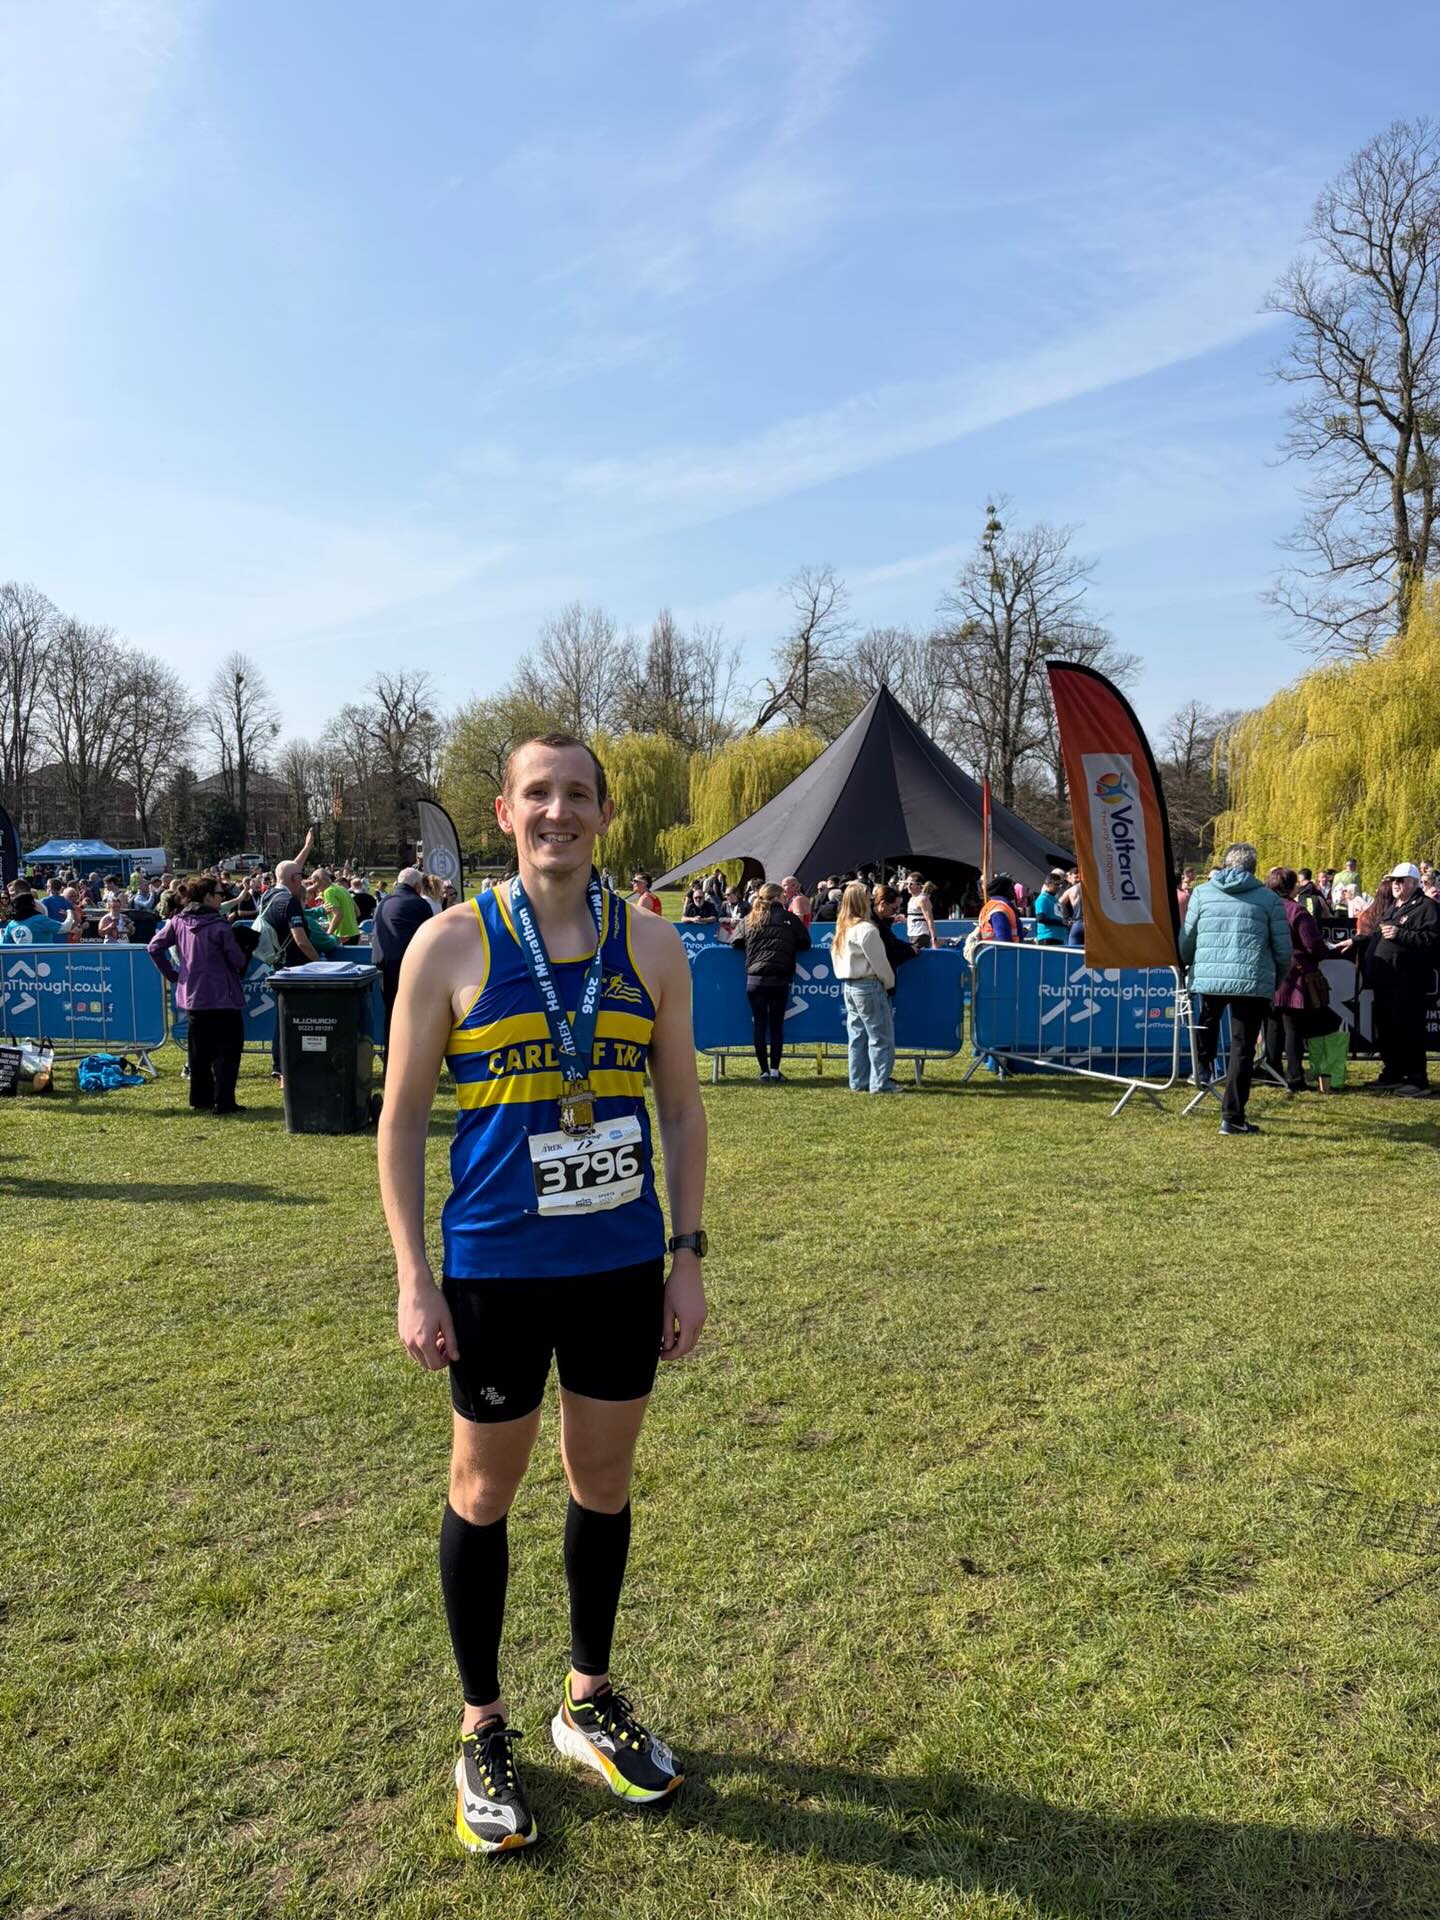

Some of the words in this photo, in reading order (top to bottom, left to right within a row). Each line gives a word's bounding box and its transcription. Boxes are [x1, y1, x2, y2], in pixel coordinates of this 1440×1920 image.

[1110, 804, 1141, 901] Voltarol
[519, 907, 550, 979] Marathon
[539, 980, 560, 1012] Half
[581, 977, 599, 1015] 2026
[557, 1020, 577, 1057] TREK
[539, 1145, 639, 1195] 3796
